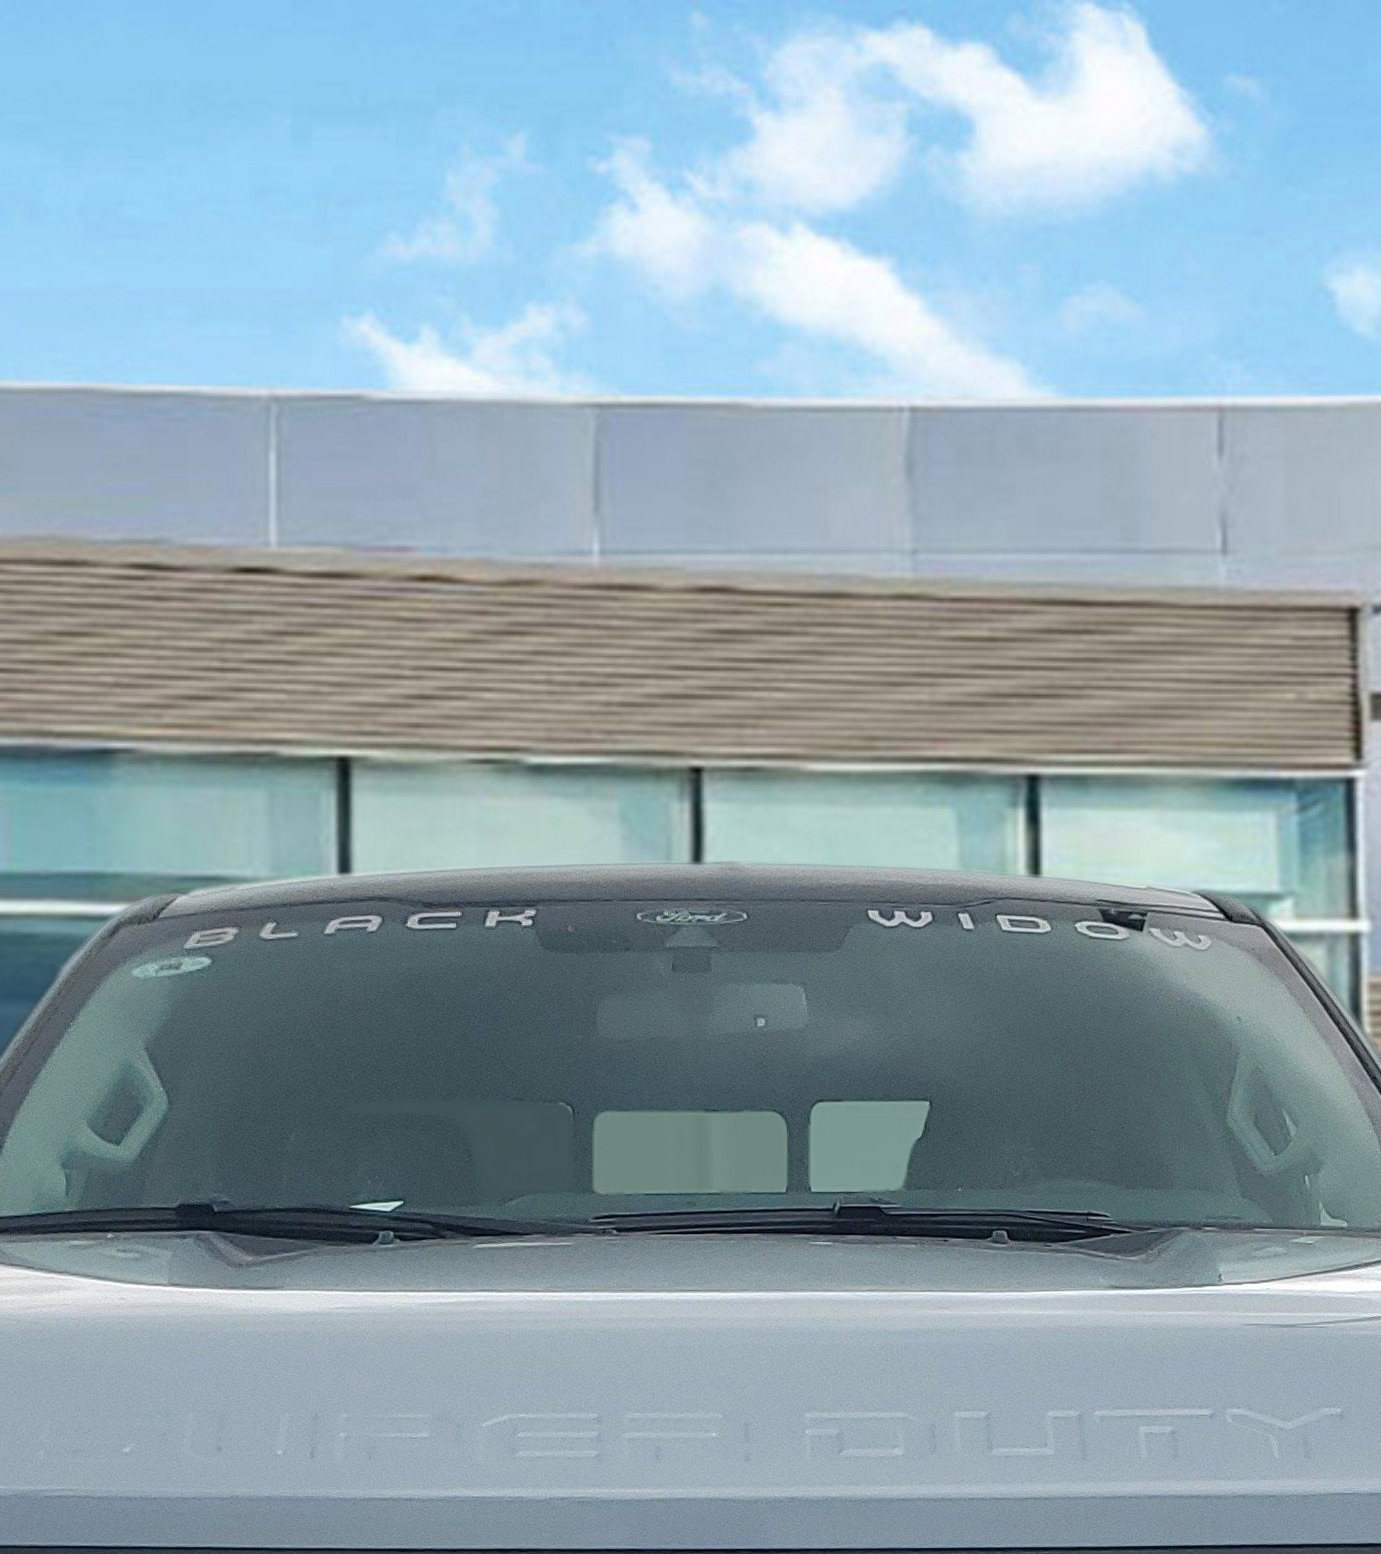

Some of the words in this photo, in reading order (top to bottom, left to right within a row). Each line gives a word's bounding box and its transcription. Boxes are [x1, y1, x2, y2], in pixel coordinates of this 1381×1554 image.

[182, 908, 537, 950] BLACK
[867, 909, 1212, 950] WIDOW
[805, 1408, 1344, 1461] DUTY
